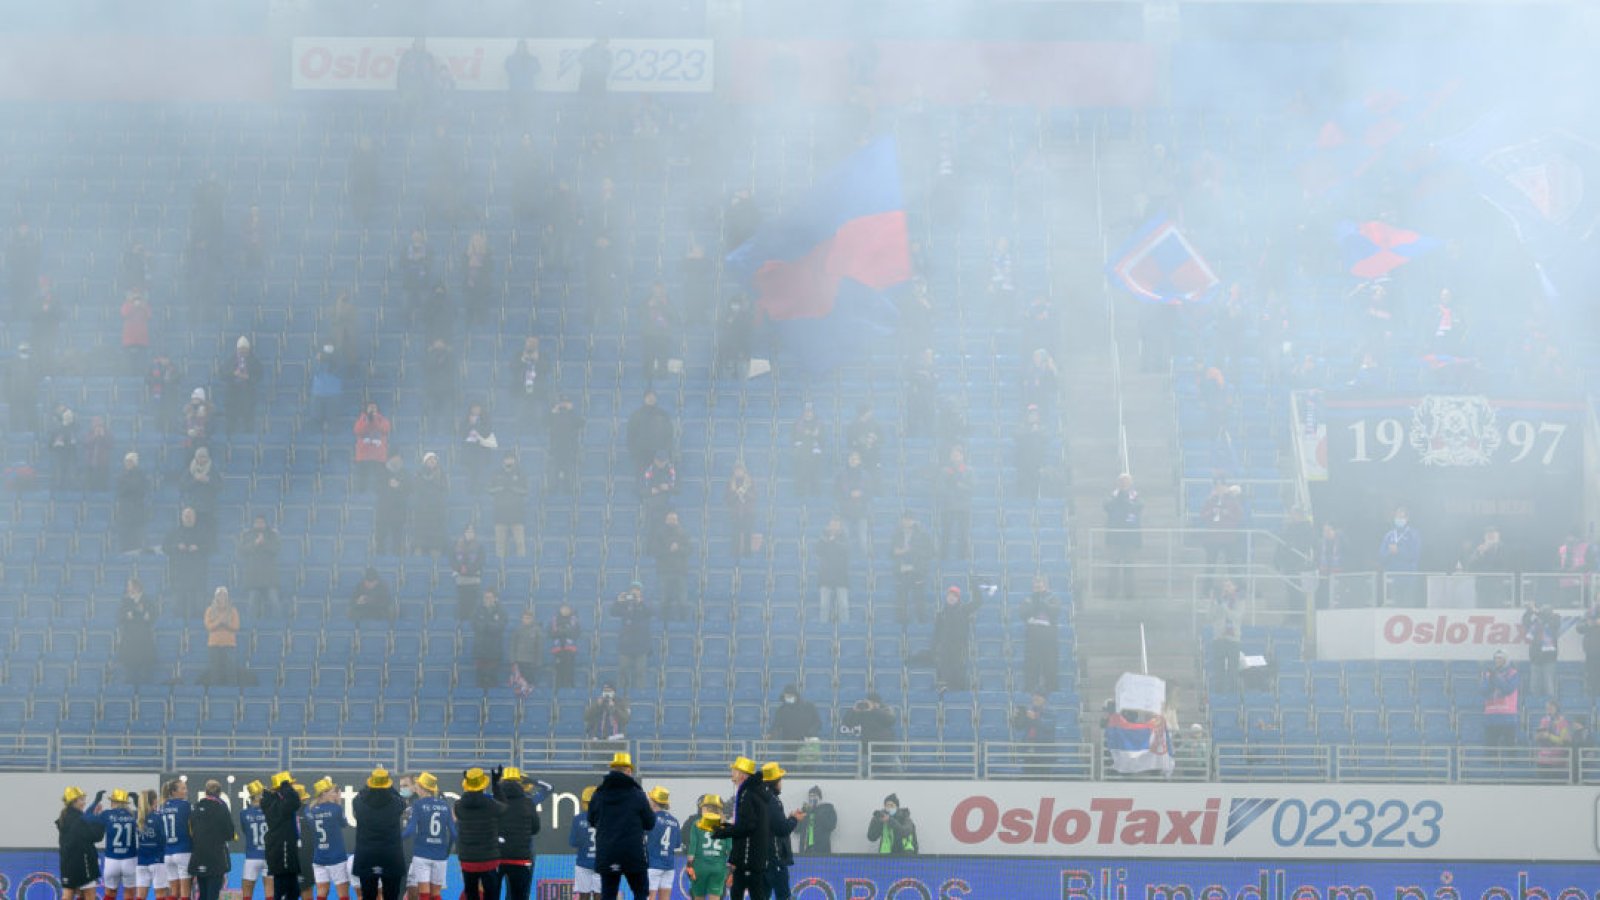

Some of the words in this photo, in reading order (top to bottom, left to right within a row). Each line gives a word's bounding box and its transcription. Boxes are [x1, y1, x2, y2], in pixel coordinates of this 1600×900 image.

[299, 46, 485, 80] Osloxi
[611, 48, 706, 81] 2323
[1348, 419, 1404, 463] 19
[1507, 420, 1568, 466] 97
[314, 819, 327, 844] 5
[430, 812, 441, 837] 6
[951, 795, 1221, 845] OsloTaxi
[1272, 797, 1444, 848] 02323
[112, 822, 133, 848] 21
[660, 826, 671, 851] 4
